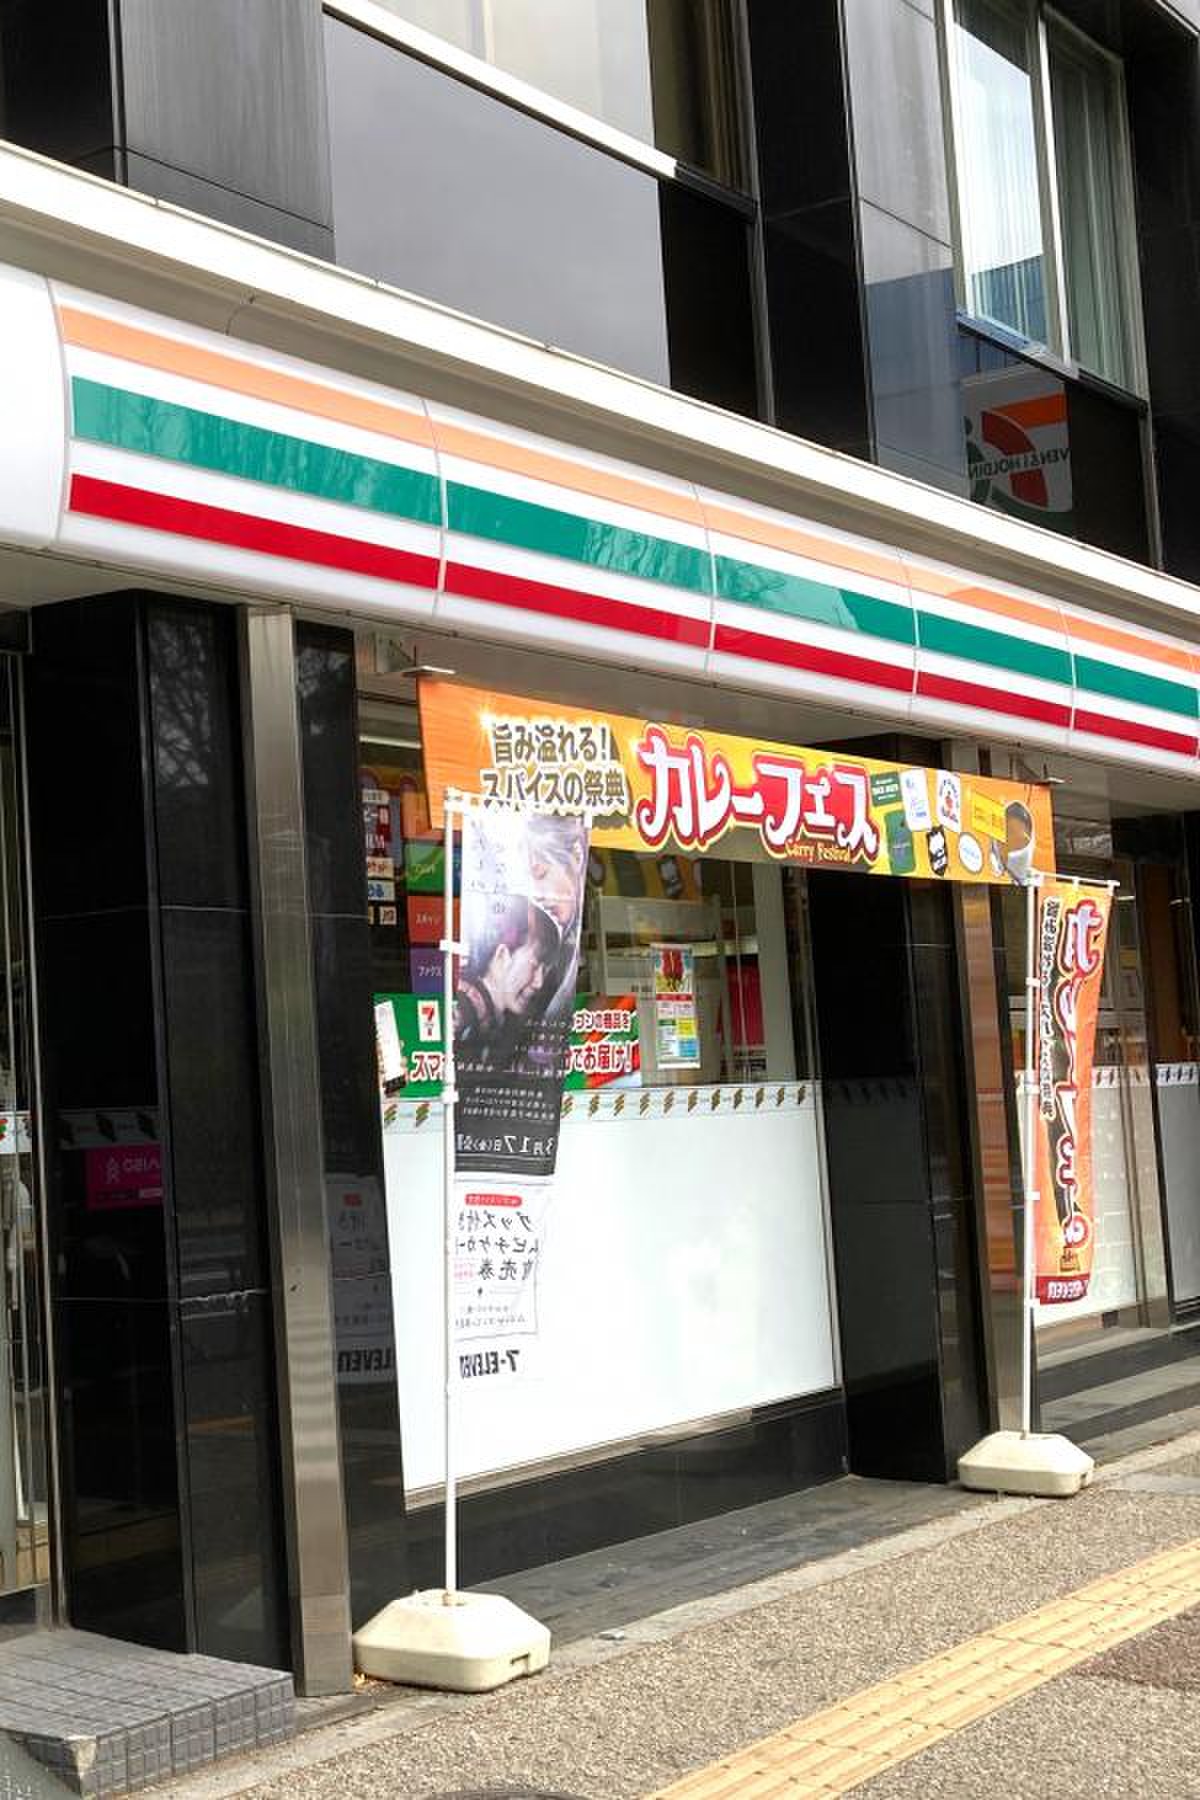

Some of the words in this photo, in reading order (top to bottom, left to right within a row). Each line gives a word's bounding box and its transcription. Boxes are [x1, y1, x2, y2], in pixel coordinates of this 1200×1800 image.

[638, 732, 879, 856] カレーフェス
[412, 1052, 447, 1080] スマ
